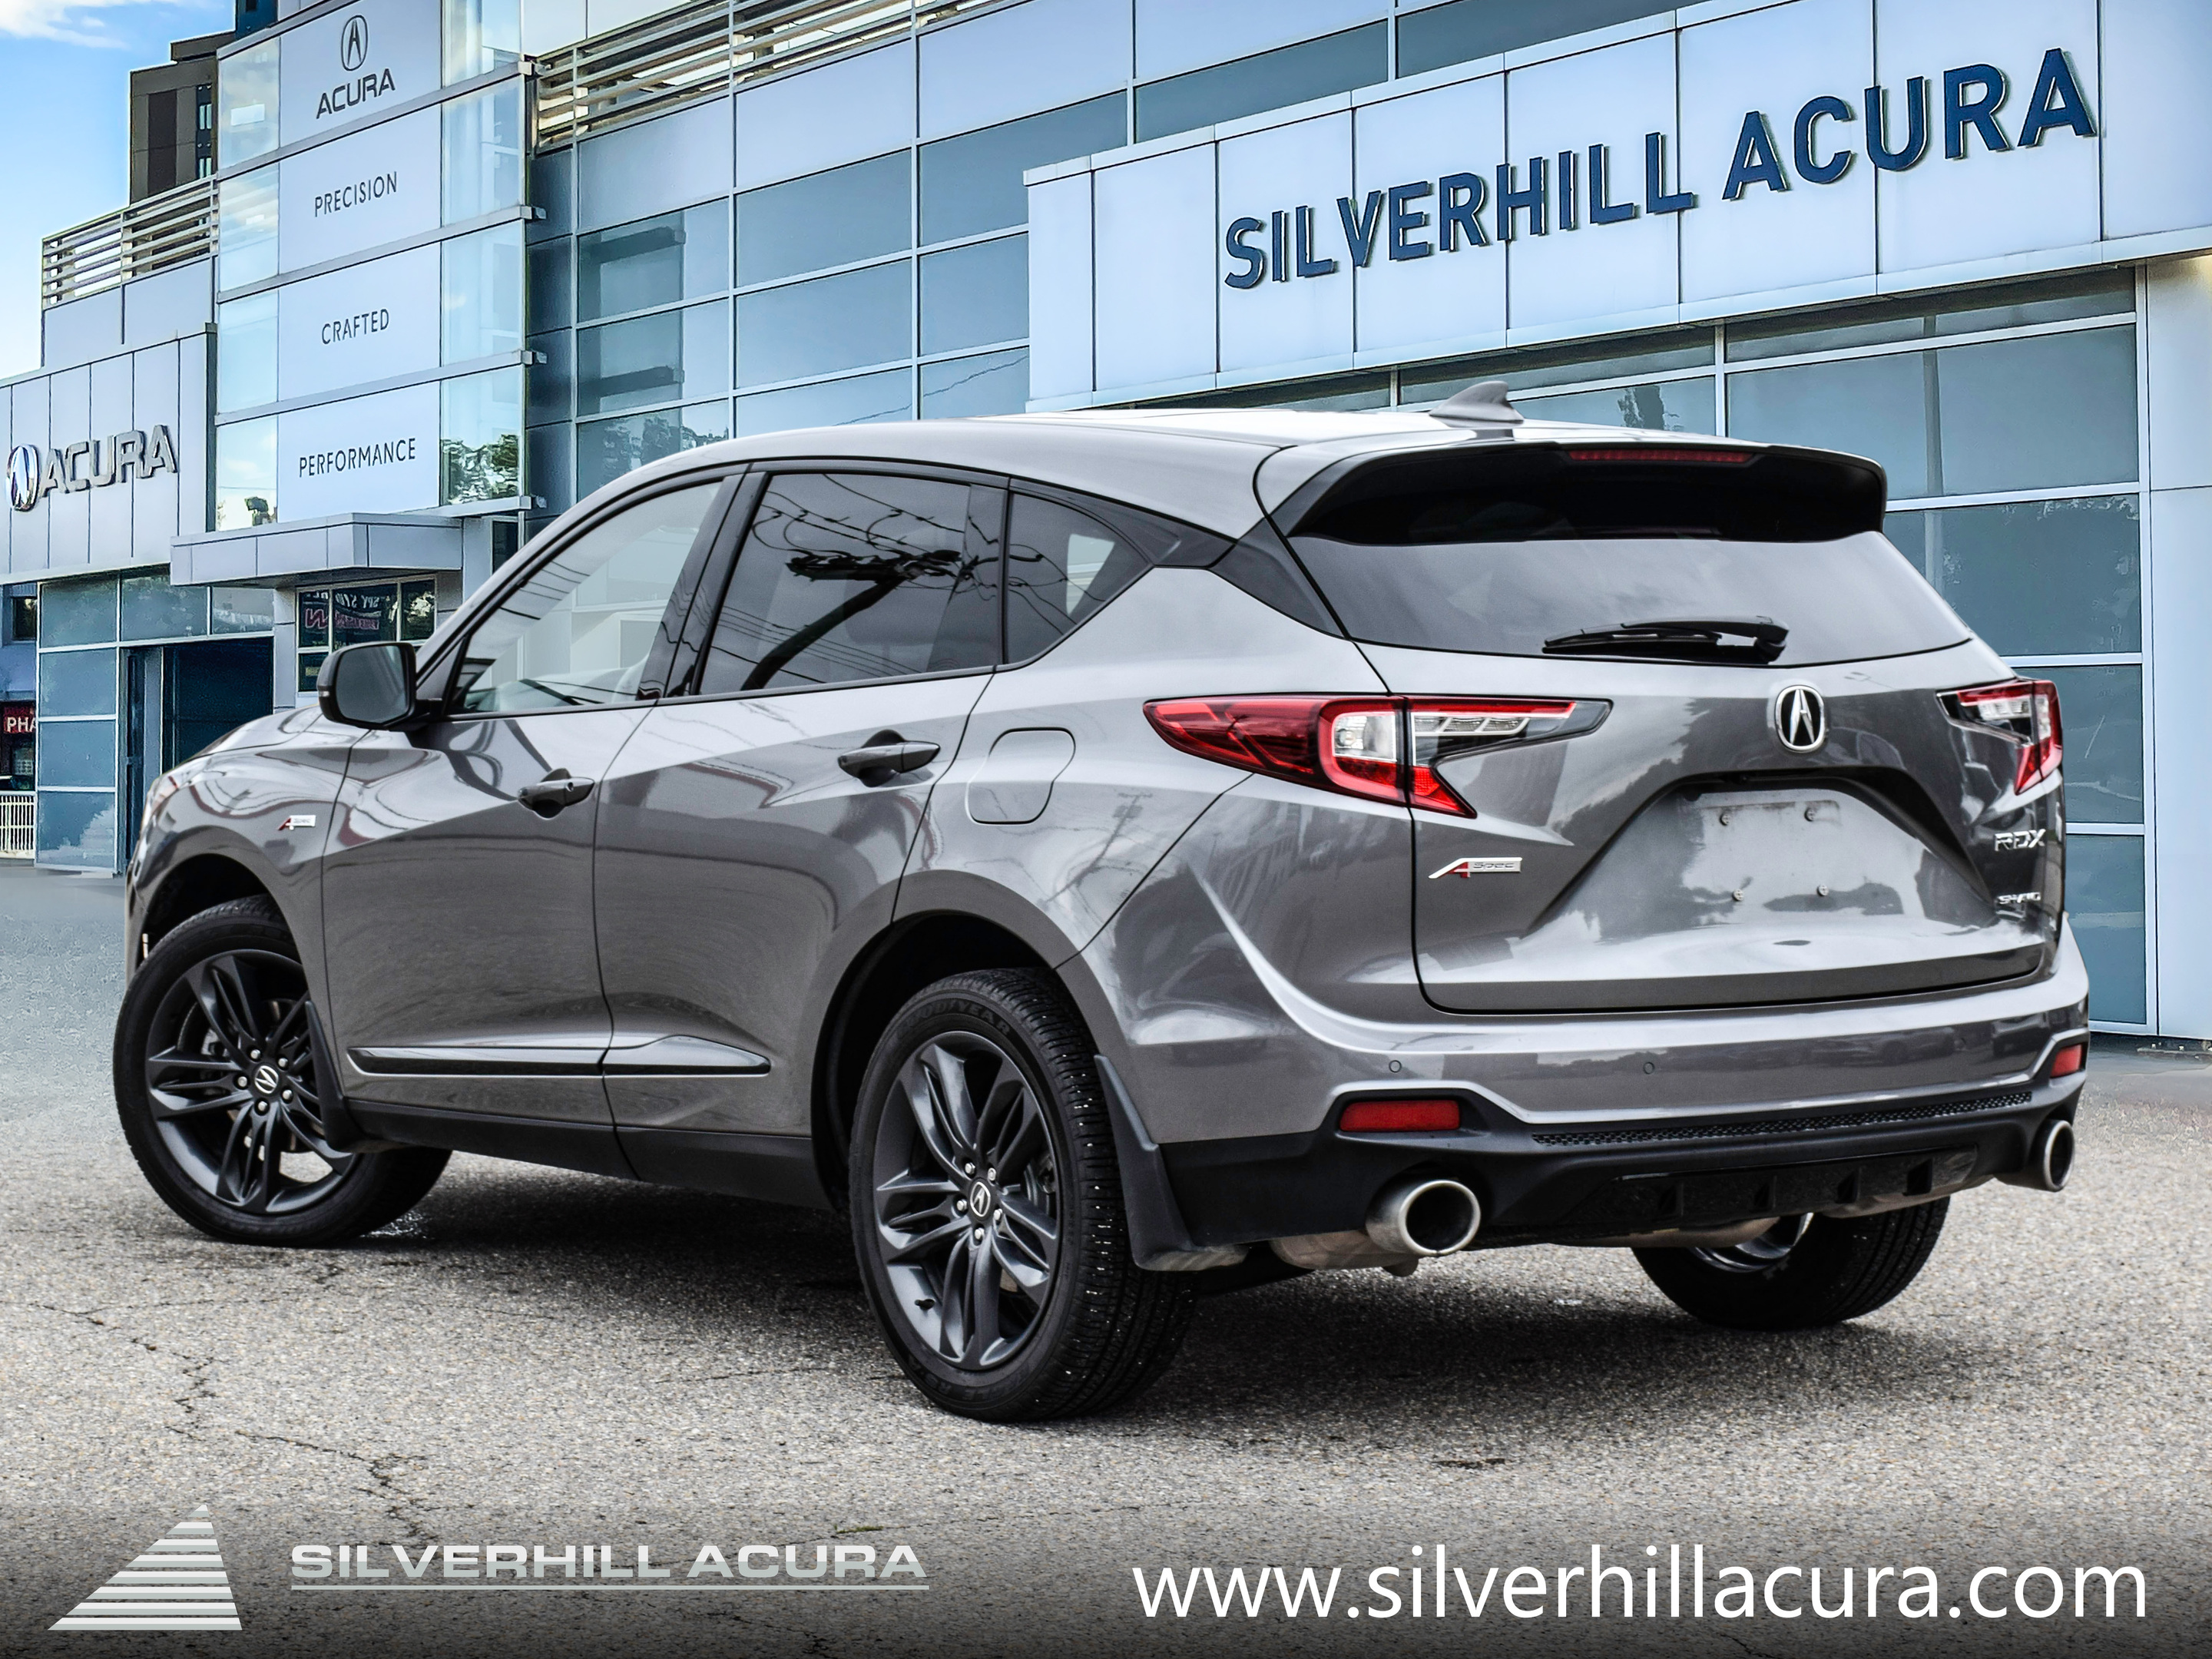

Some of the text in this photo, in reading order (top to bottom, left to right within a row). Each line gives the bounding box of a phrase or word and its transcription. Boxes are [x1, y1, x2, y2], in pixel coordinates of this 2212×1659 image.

[316, 68, 396, 120] ACURA
[1224, 48, 2098, 290] SILVERHILL ACURA
[315, 171, 397, 217] PRECISION
[322, 308, 389, 345] CRAFTED
[38, 424, 179, 498] ACURA
[299, 437, 416, 478] PERFORMANCE
[1995, 829, 2046, 851] RDX
